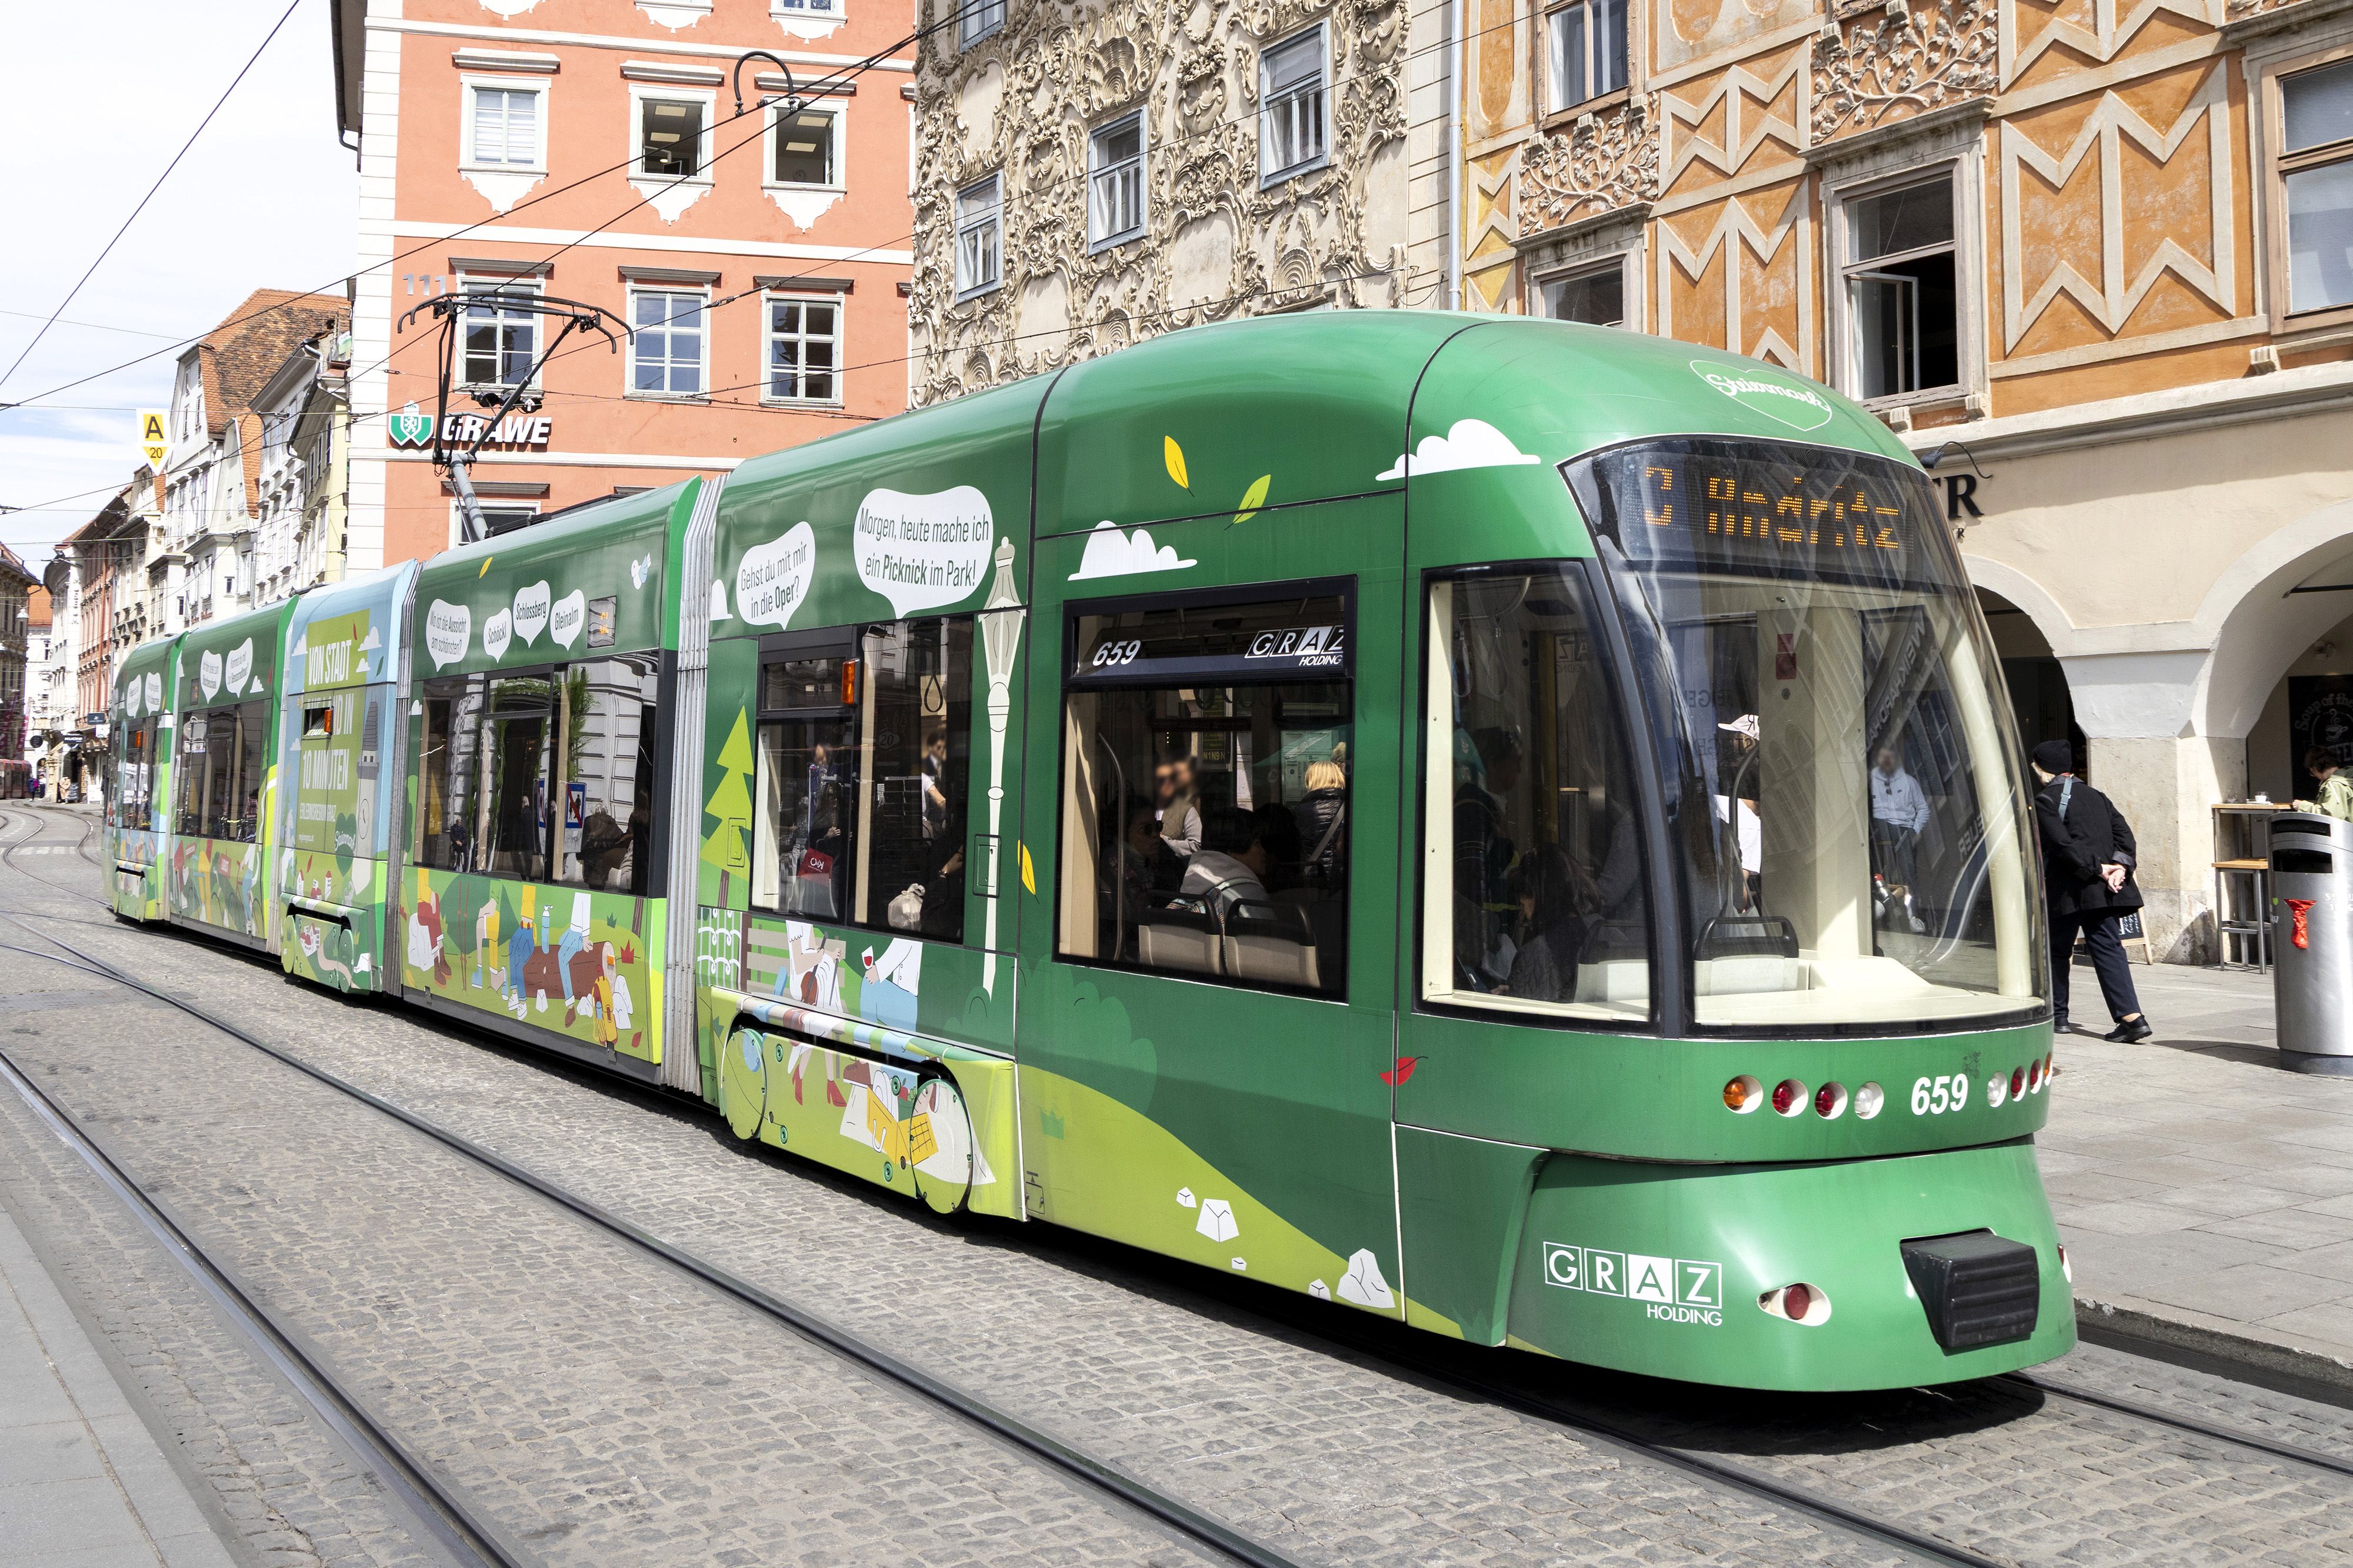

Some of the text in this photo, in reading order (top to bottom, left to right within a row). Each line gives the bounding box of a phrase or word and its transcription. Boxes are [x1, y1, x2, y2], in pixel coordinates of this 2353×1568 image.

[403, 273, 446, 296] 111
[1706, 373, 1829, 411] Steiermark
[146, 415, 164, 440] A
[442, 415, 552, 443] GRAWE
[149, 446, 163, 460] 20
[1932, 474, 1985, 518] R
[859, 508, 989, 543] Morgen, heute mache ich
[741, 541, 807, 592] Gehst du mit mir
[865, 553, 976, 588] ein Picknick im Park!
[516, 601, 546, 620] Schlossberg
[751, 576, 800, 619] in die Oper?
[449, 618, 466, 634] Aussicht
[488, 622, 506, 644] Schöckl
[555, 608, 579, 630] Gleinalm
[438, 638, 462, 656] schönsten?
[1092, 640, 1141, 666] 659
[1249, 628, 1344, 656] GRAZ
[308, 639, 352, 685] VON STADT
[1298, 654, 1343, 667] HOLDING
[2295, 701, 2321, 730] Soup
[2321, 693, 2335, 706] of
[302, 749, 349, 790] 10 MINUTEN
[1910, 1073, 1968, 1116] 659
[1547, 1246, 1717, 1305] GRAZ
[1647, 1303, 1722, 1326] HOLDING
